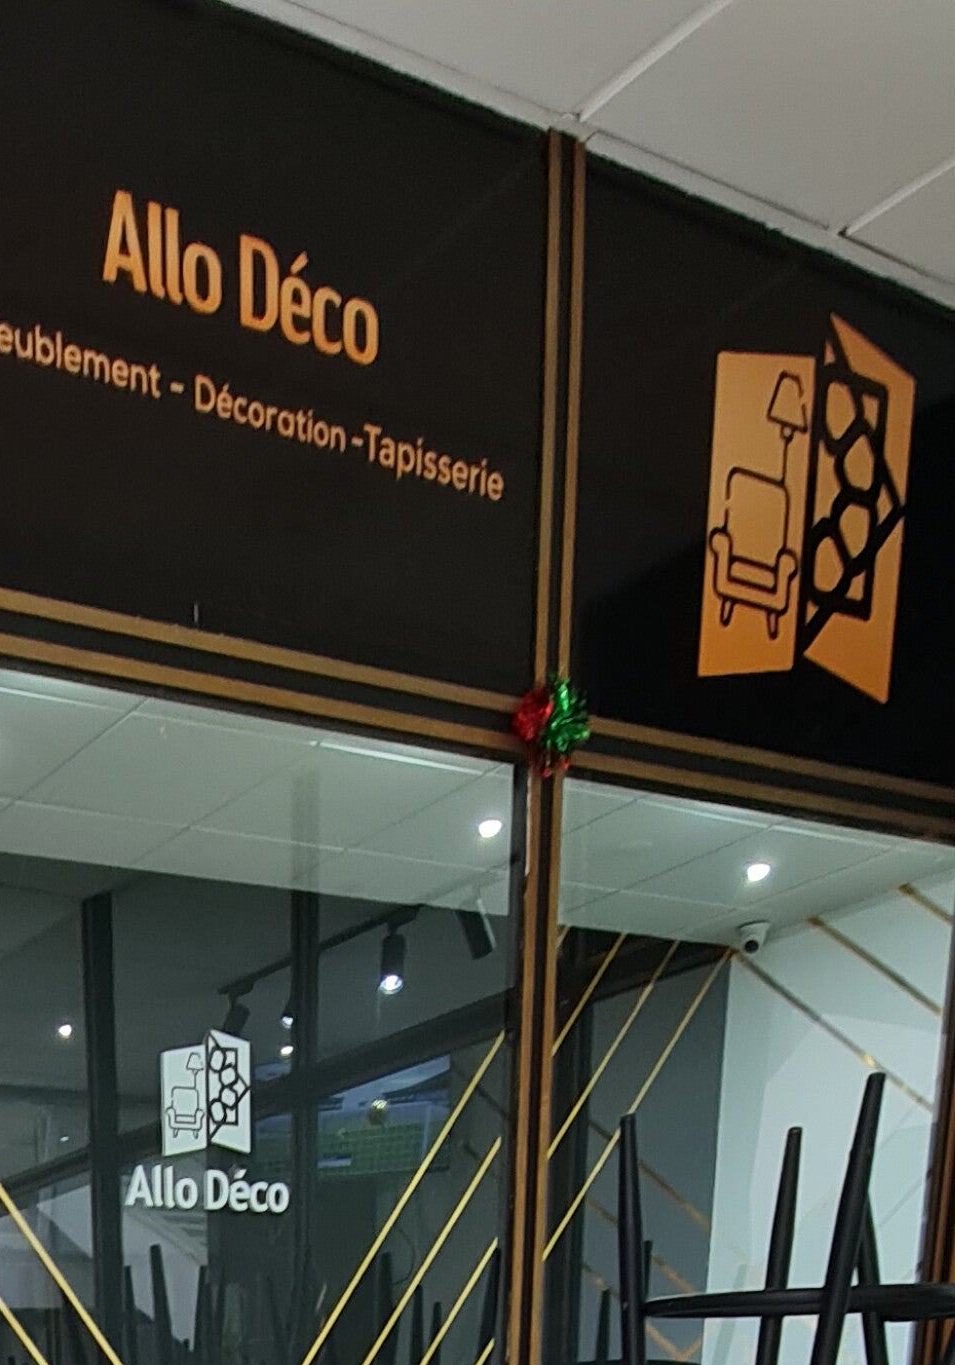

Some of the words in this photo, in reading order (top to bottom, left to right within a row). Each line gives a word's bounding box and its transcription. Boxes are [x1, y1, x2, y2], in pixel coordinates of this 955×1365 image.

[102, 189, 223, 314] Allo
[239, 233, 379, 366] Déco
[194, 373, 347, 453] Décoration
[124, 1164, 198, 1210] Allo
[203, 1168, 290, 1213] Déco
